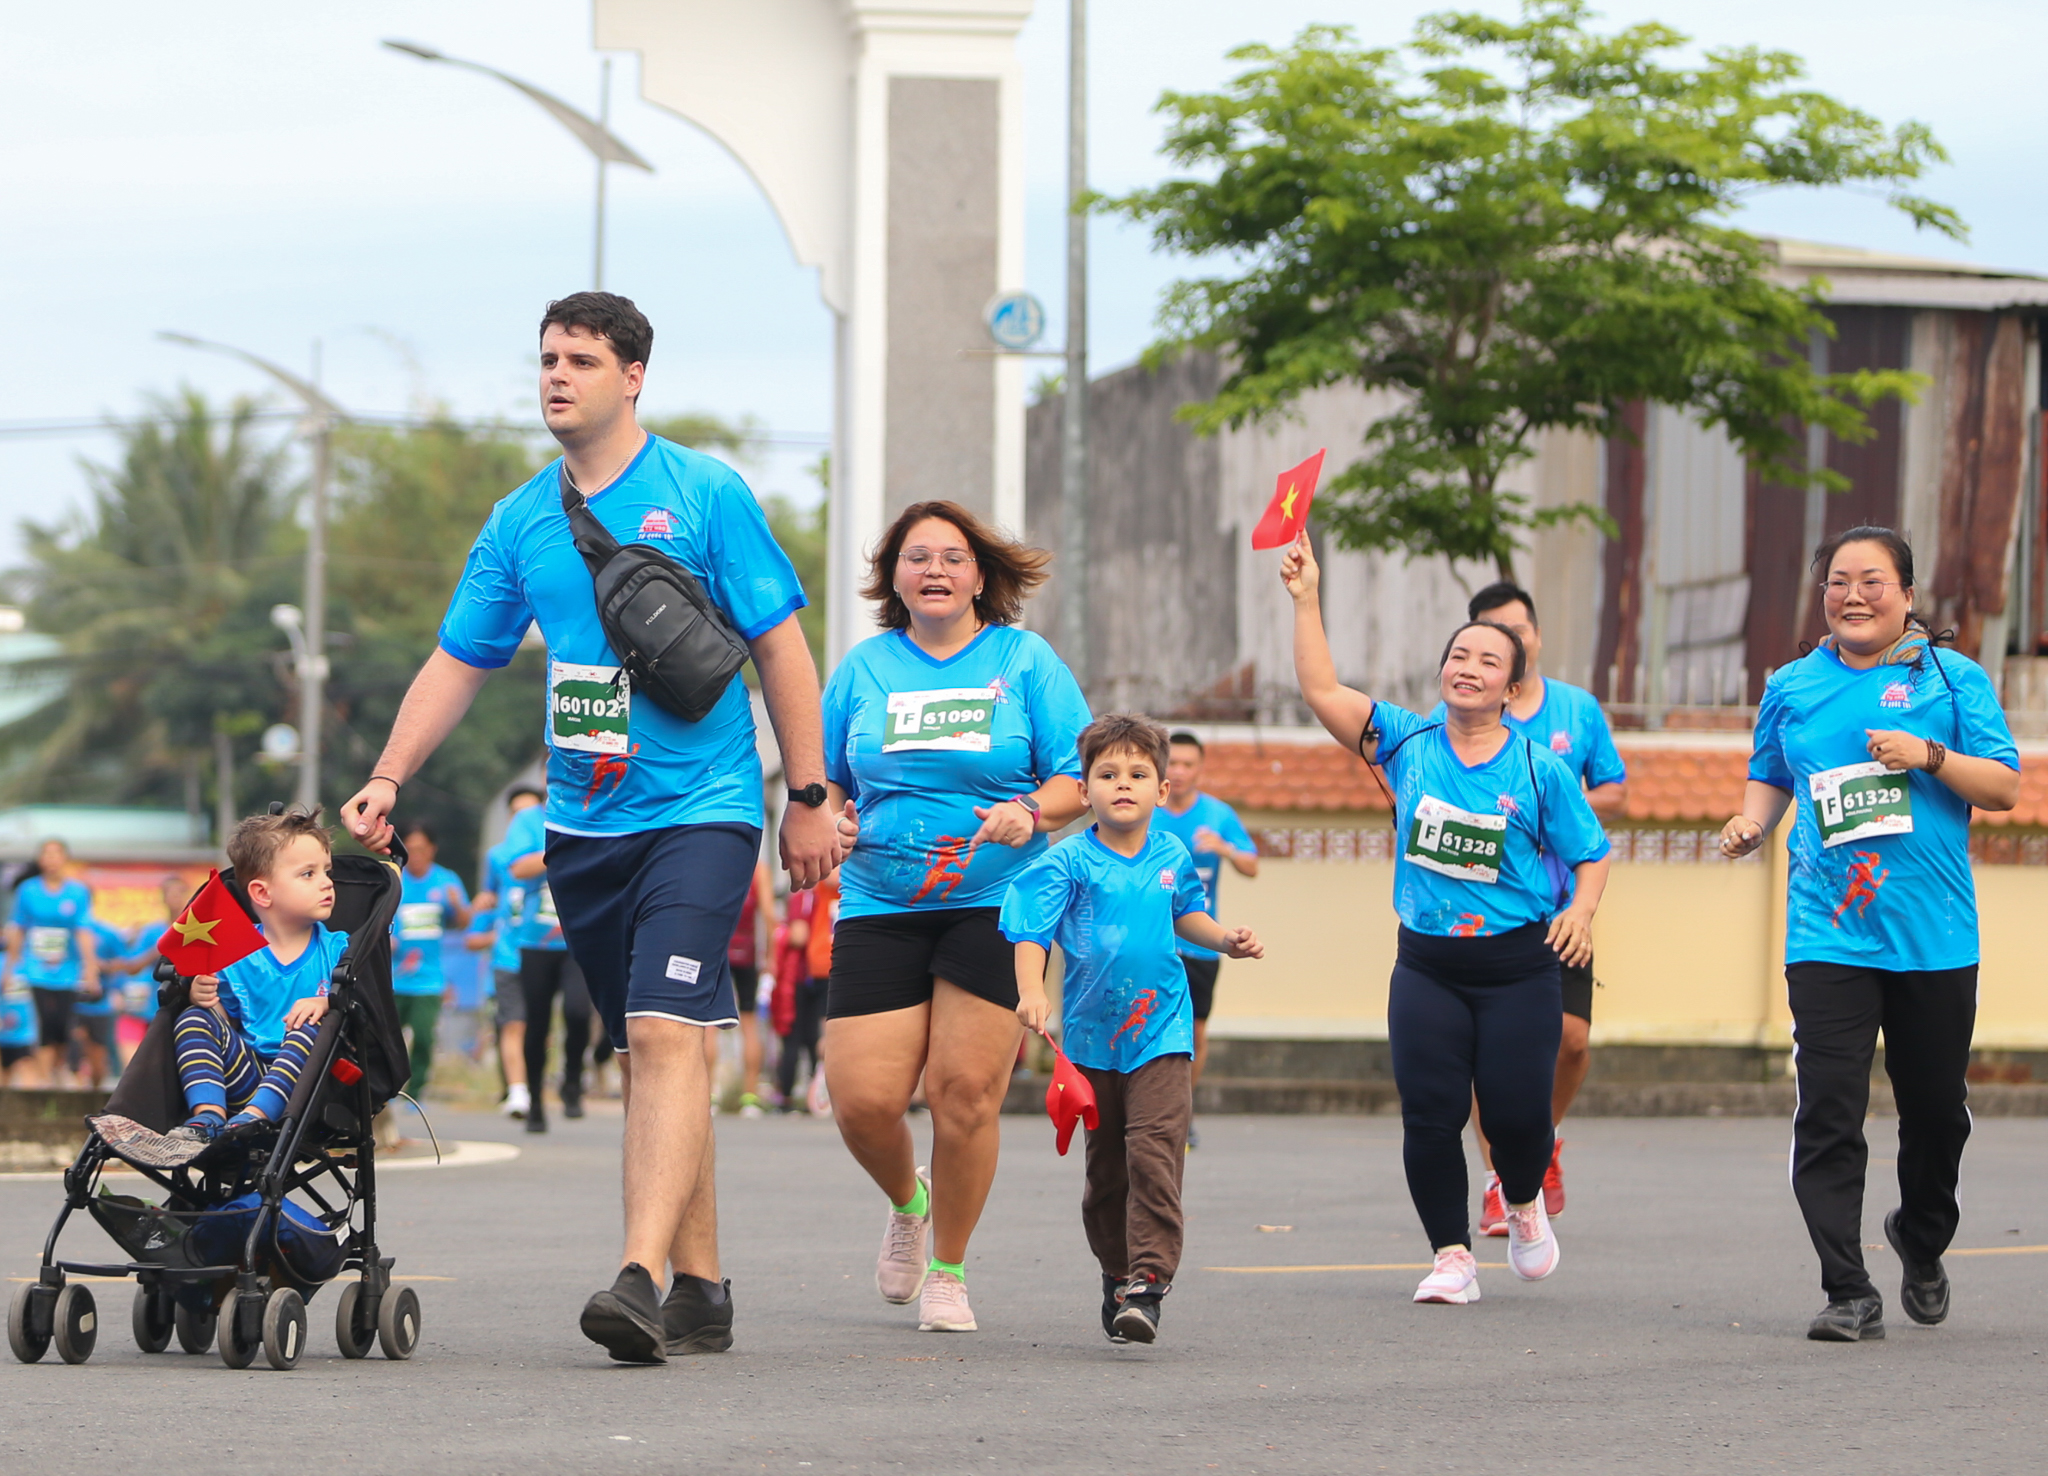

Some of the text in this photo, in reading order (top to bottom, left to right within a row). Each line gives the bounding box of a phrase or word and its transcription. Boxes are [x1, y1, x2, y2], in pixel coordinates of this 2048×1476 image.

[903, 709, 986, 726] F 61090
[1827, 797, 1837, 815] F
[1843, 787, 1902, 810] 61329
[1424, 824, 1437, 839] F
[1442, 832, 1497, 856] 61328
